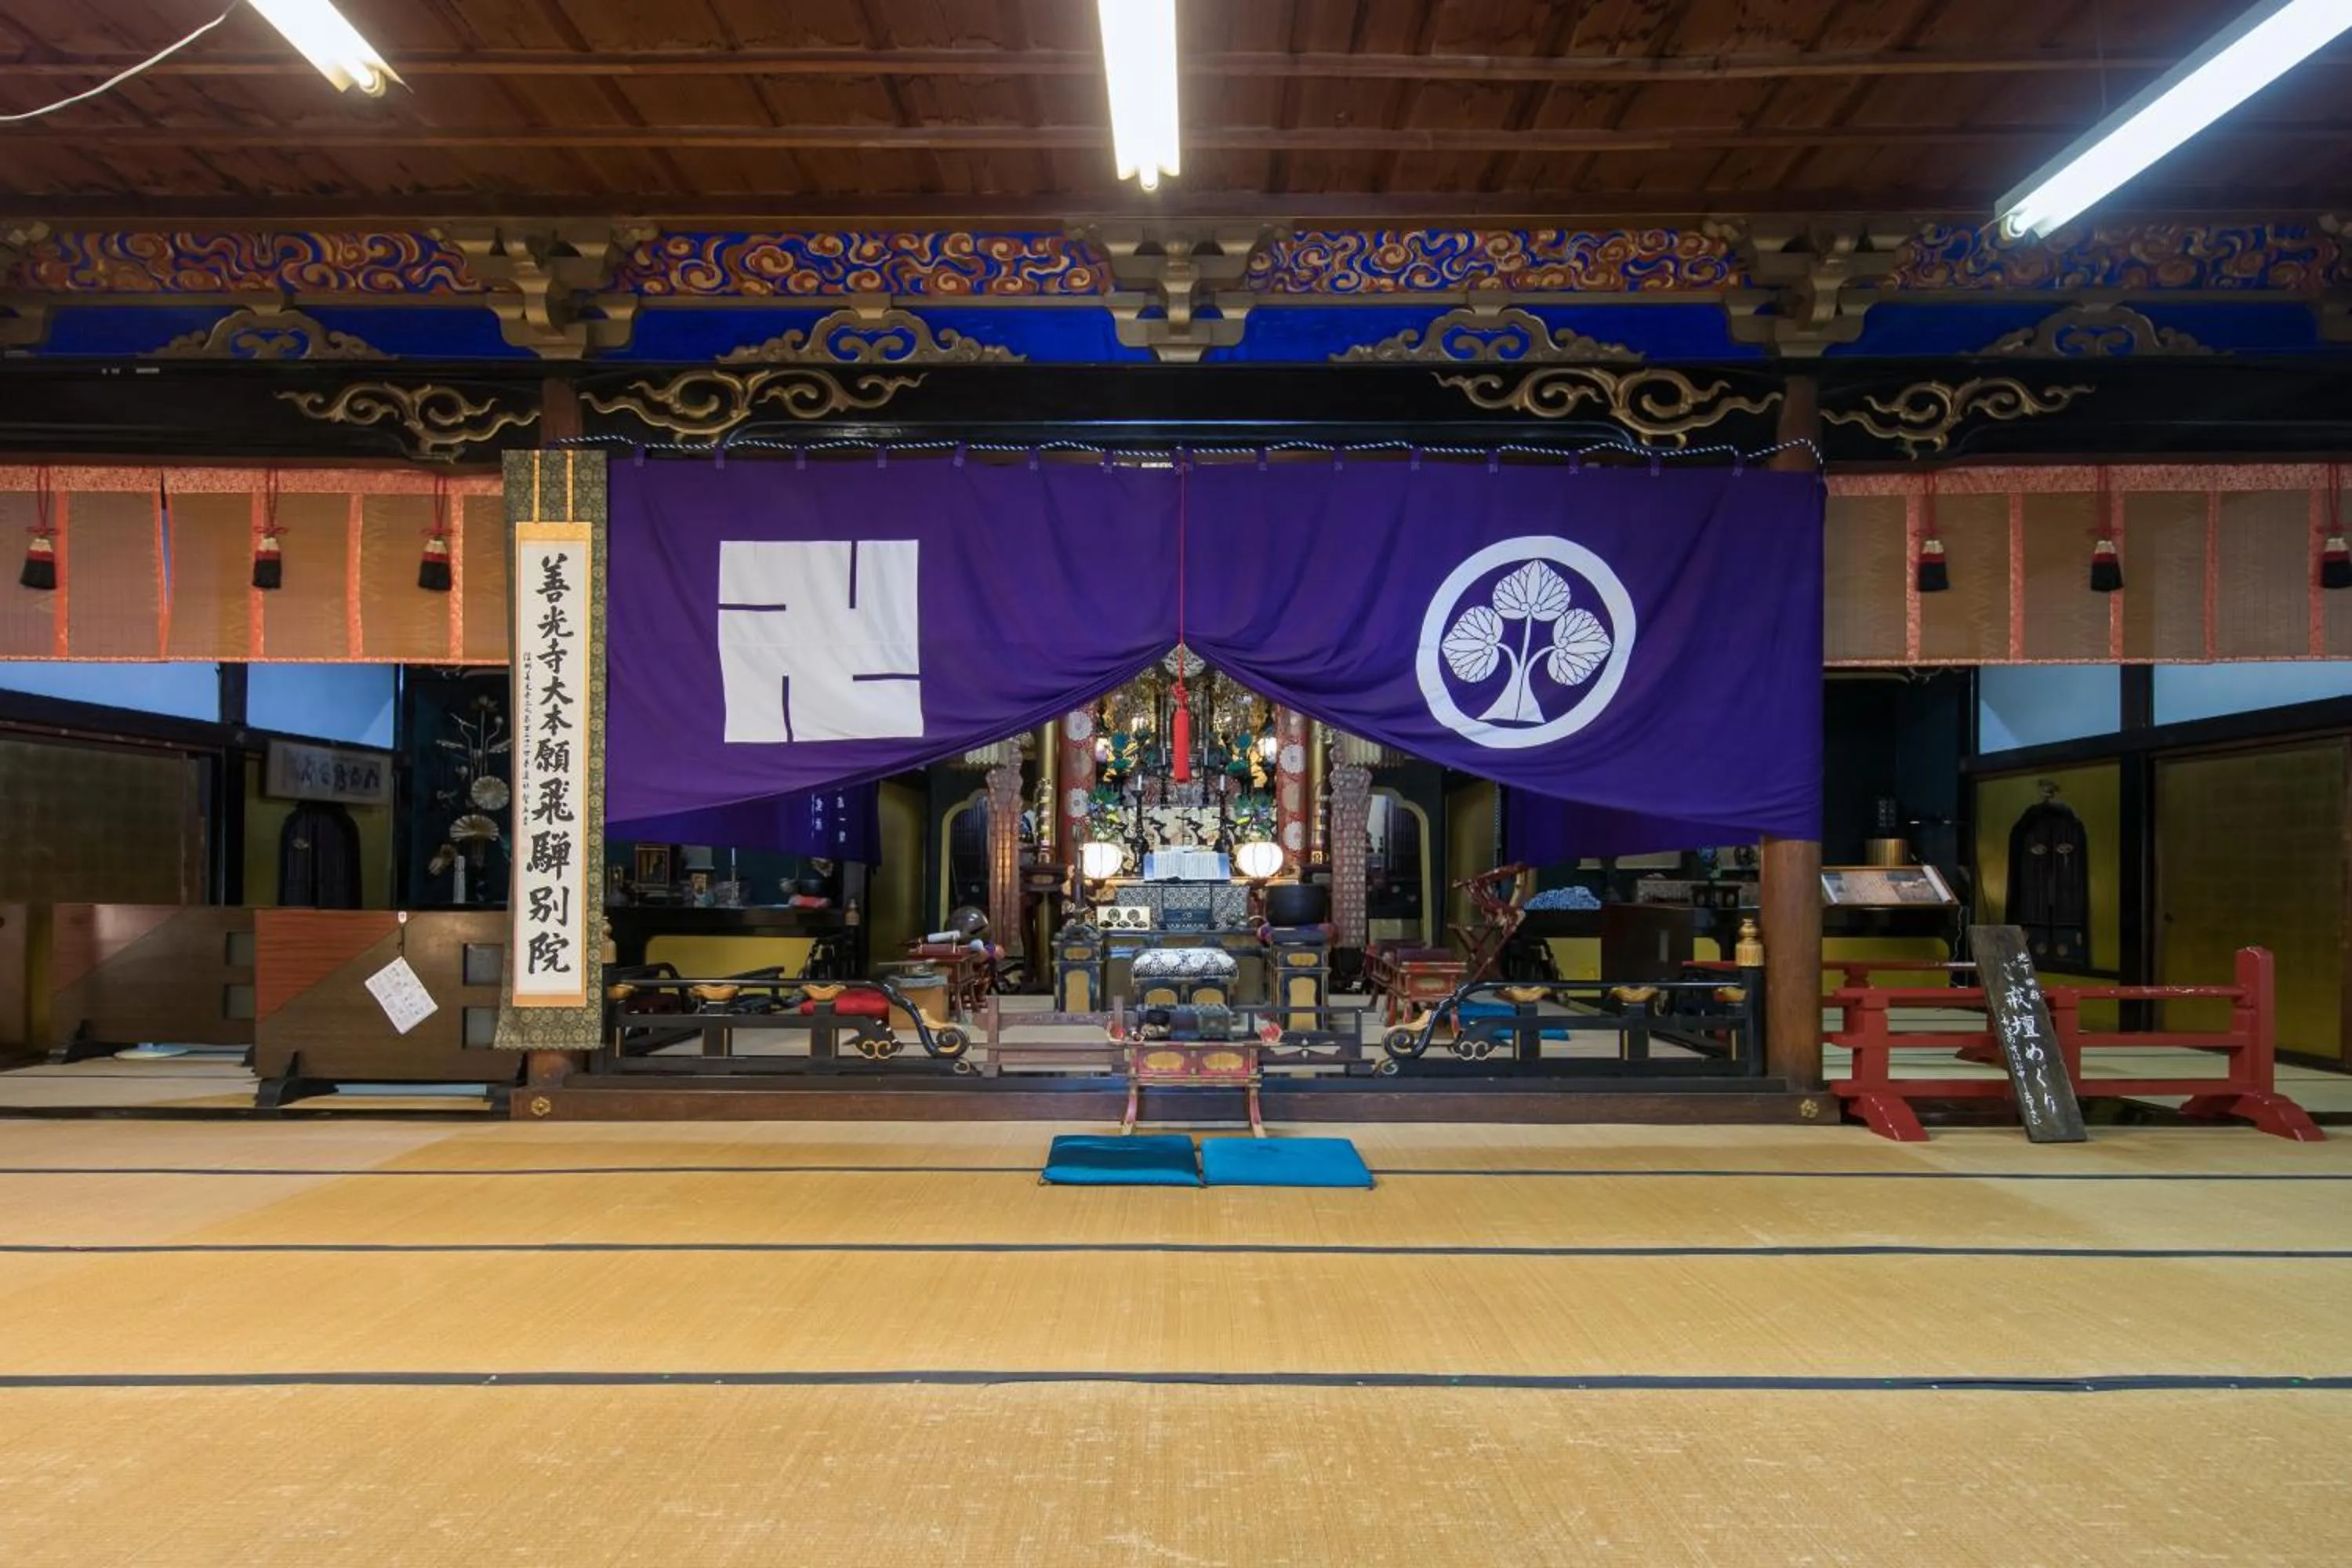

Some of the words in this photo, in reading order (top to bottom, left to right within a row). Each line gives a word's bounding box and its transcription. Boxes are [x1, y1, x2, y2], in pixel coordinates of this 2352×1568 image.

[526, 553, 575, 975] 善光寺大本願飛騨別院
[2003, 960, 2056, 1114] ご戒壇めぐり
